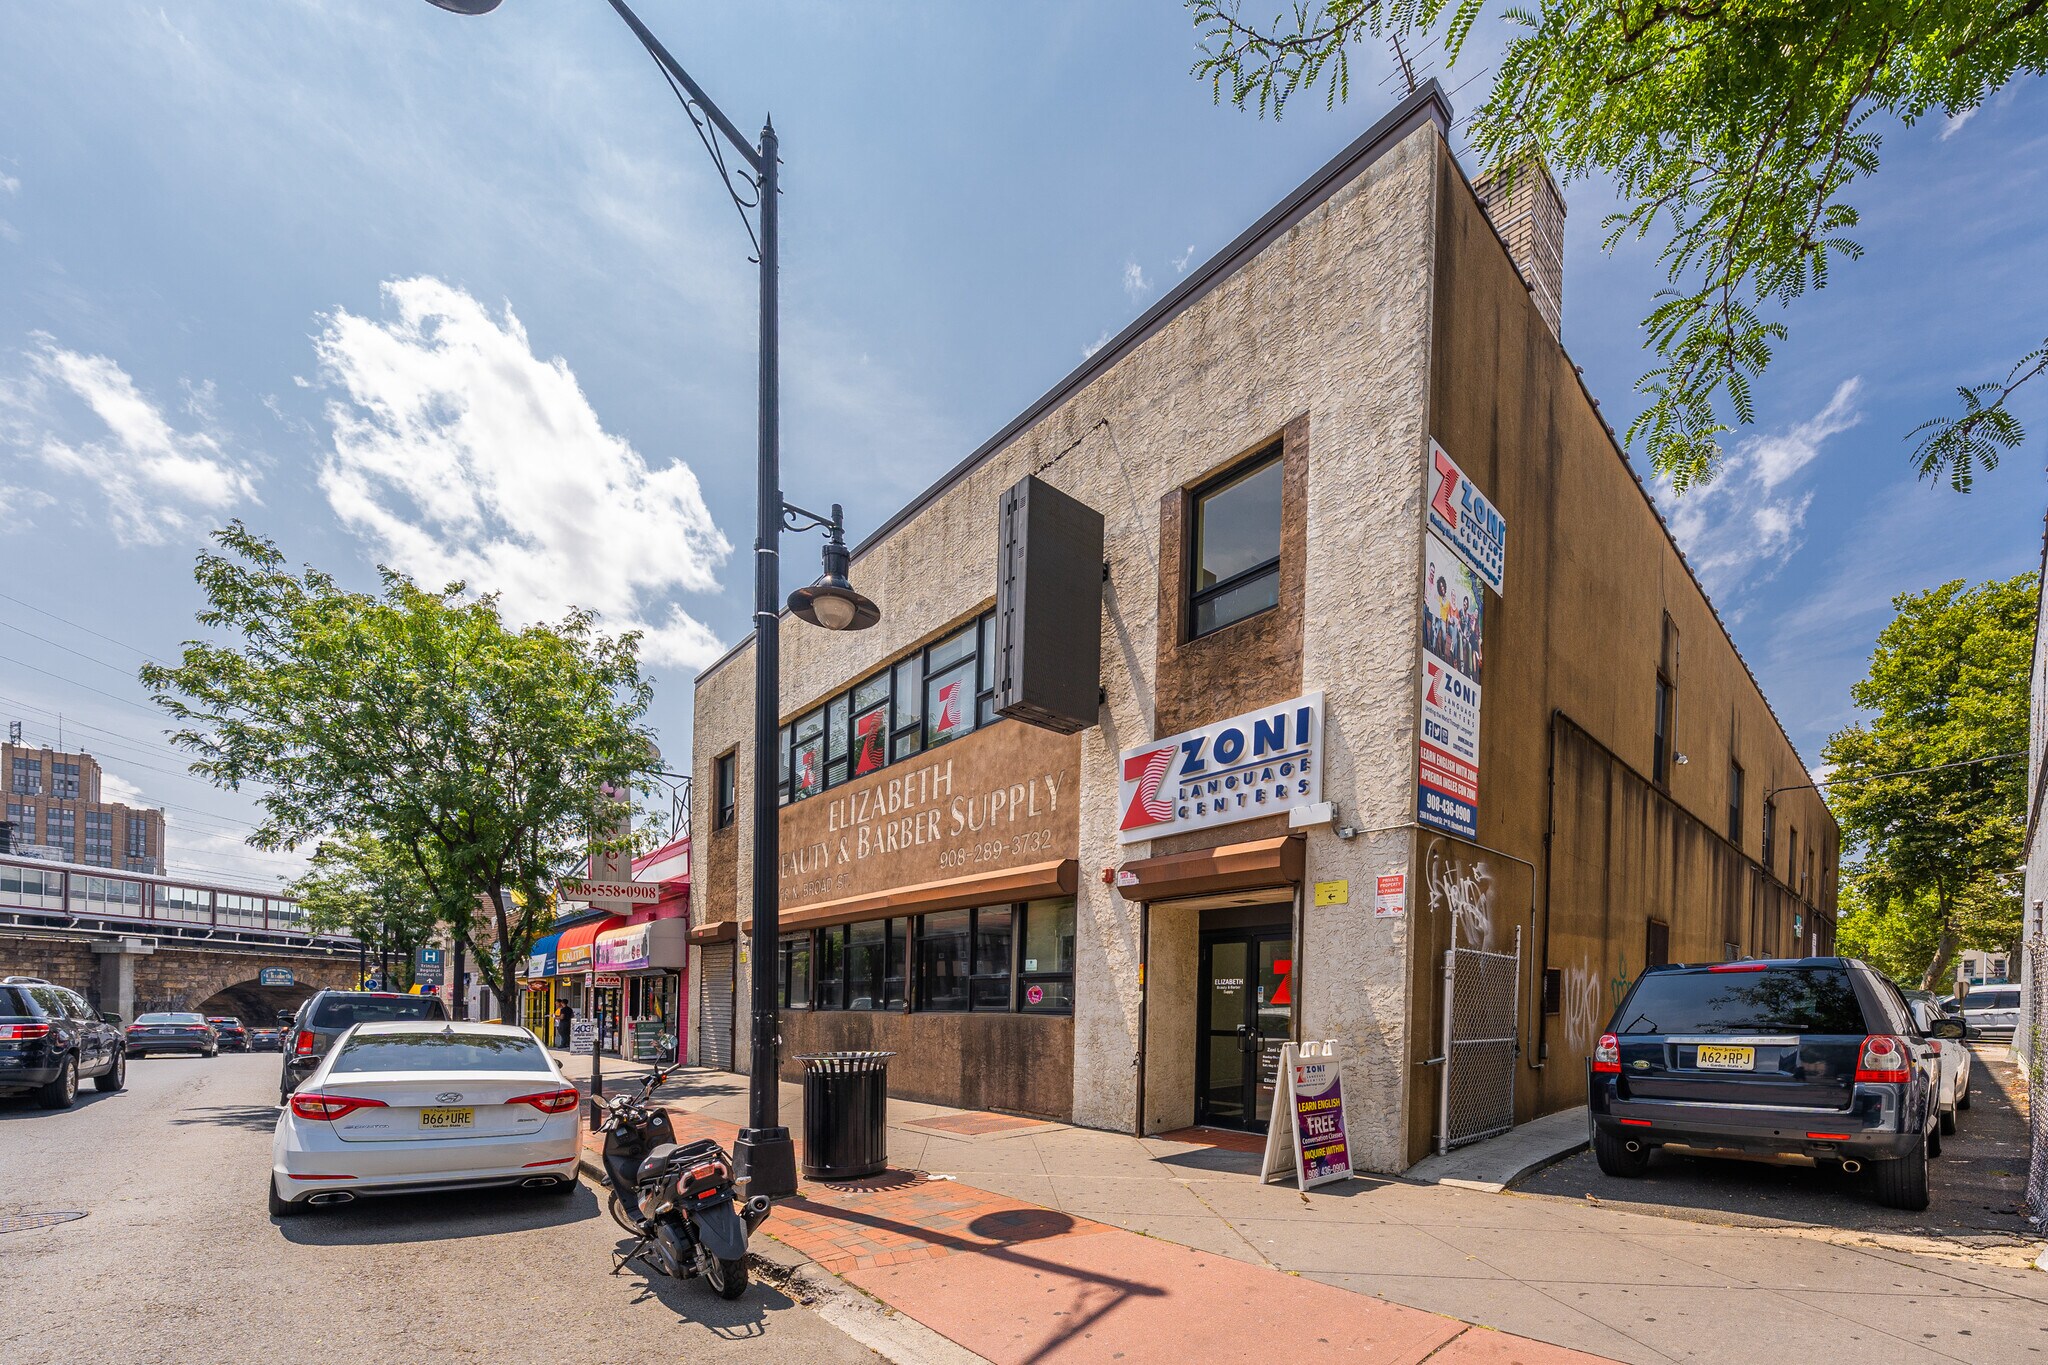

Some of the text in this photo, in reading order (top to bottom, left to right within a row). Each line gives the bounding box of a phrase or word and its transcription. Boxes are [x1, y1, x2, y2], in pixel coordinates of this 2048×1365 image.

[1461, 480, 1506, 546] ZONI
[1460, 526, 1503, 575] CENTERS
[1445, 673, 1475, 707] ZONI
[1443, 705, 1475, 728] CENTERS
[1444, 695, 1475, 720] LANGUAGE
[1179, 706, 1313, 776] ZONI
[1436, 753, 1456, 774] ENGLISH
[1179, 757, 1312, 800] LANGUAGE
[829, 758, 953, 833] ELIZABETH
[1178, 778, 1311, 819] CENTERS
[1426, 792, 1471, 824] 908-436-0900
[779, 769, 1066, 880] EAUTY & BARBER SUPPLY
[939, 829, 1052, 871] 908-289-3732
[803, 876, 833, 898] BROAD
[1379, 881, 1401, 889] PROPERTY
[425, 951, 436, 962] H
[1306, 1064, 1326, 1074] ZONI
[1701, 1052, 1751, 1065] A62 RPJ
[1298, 1098, 1341, 1113] LEARN ENGLISH
[423, 1112, 471, 1125] B66 URE
[1308, 1114, 1336, 1136] FREE
[1302, 1132, 1344, 1145] Conversation Classes
[1304, 1143, 1345, 1160] INQUIRE WITHIN
[1321, 1162, 1346, 1176] 436-0900
